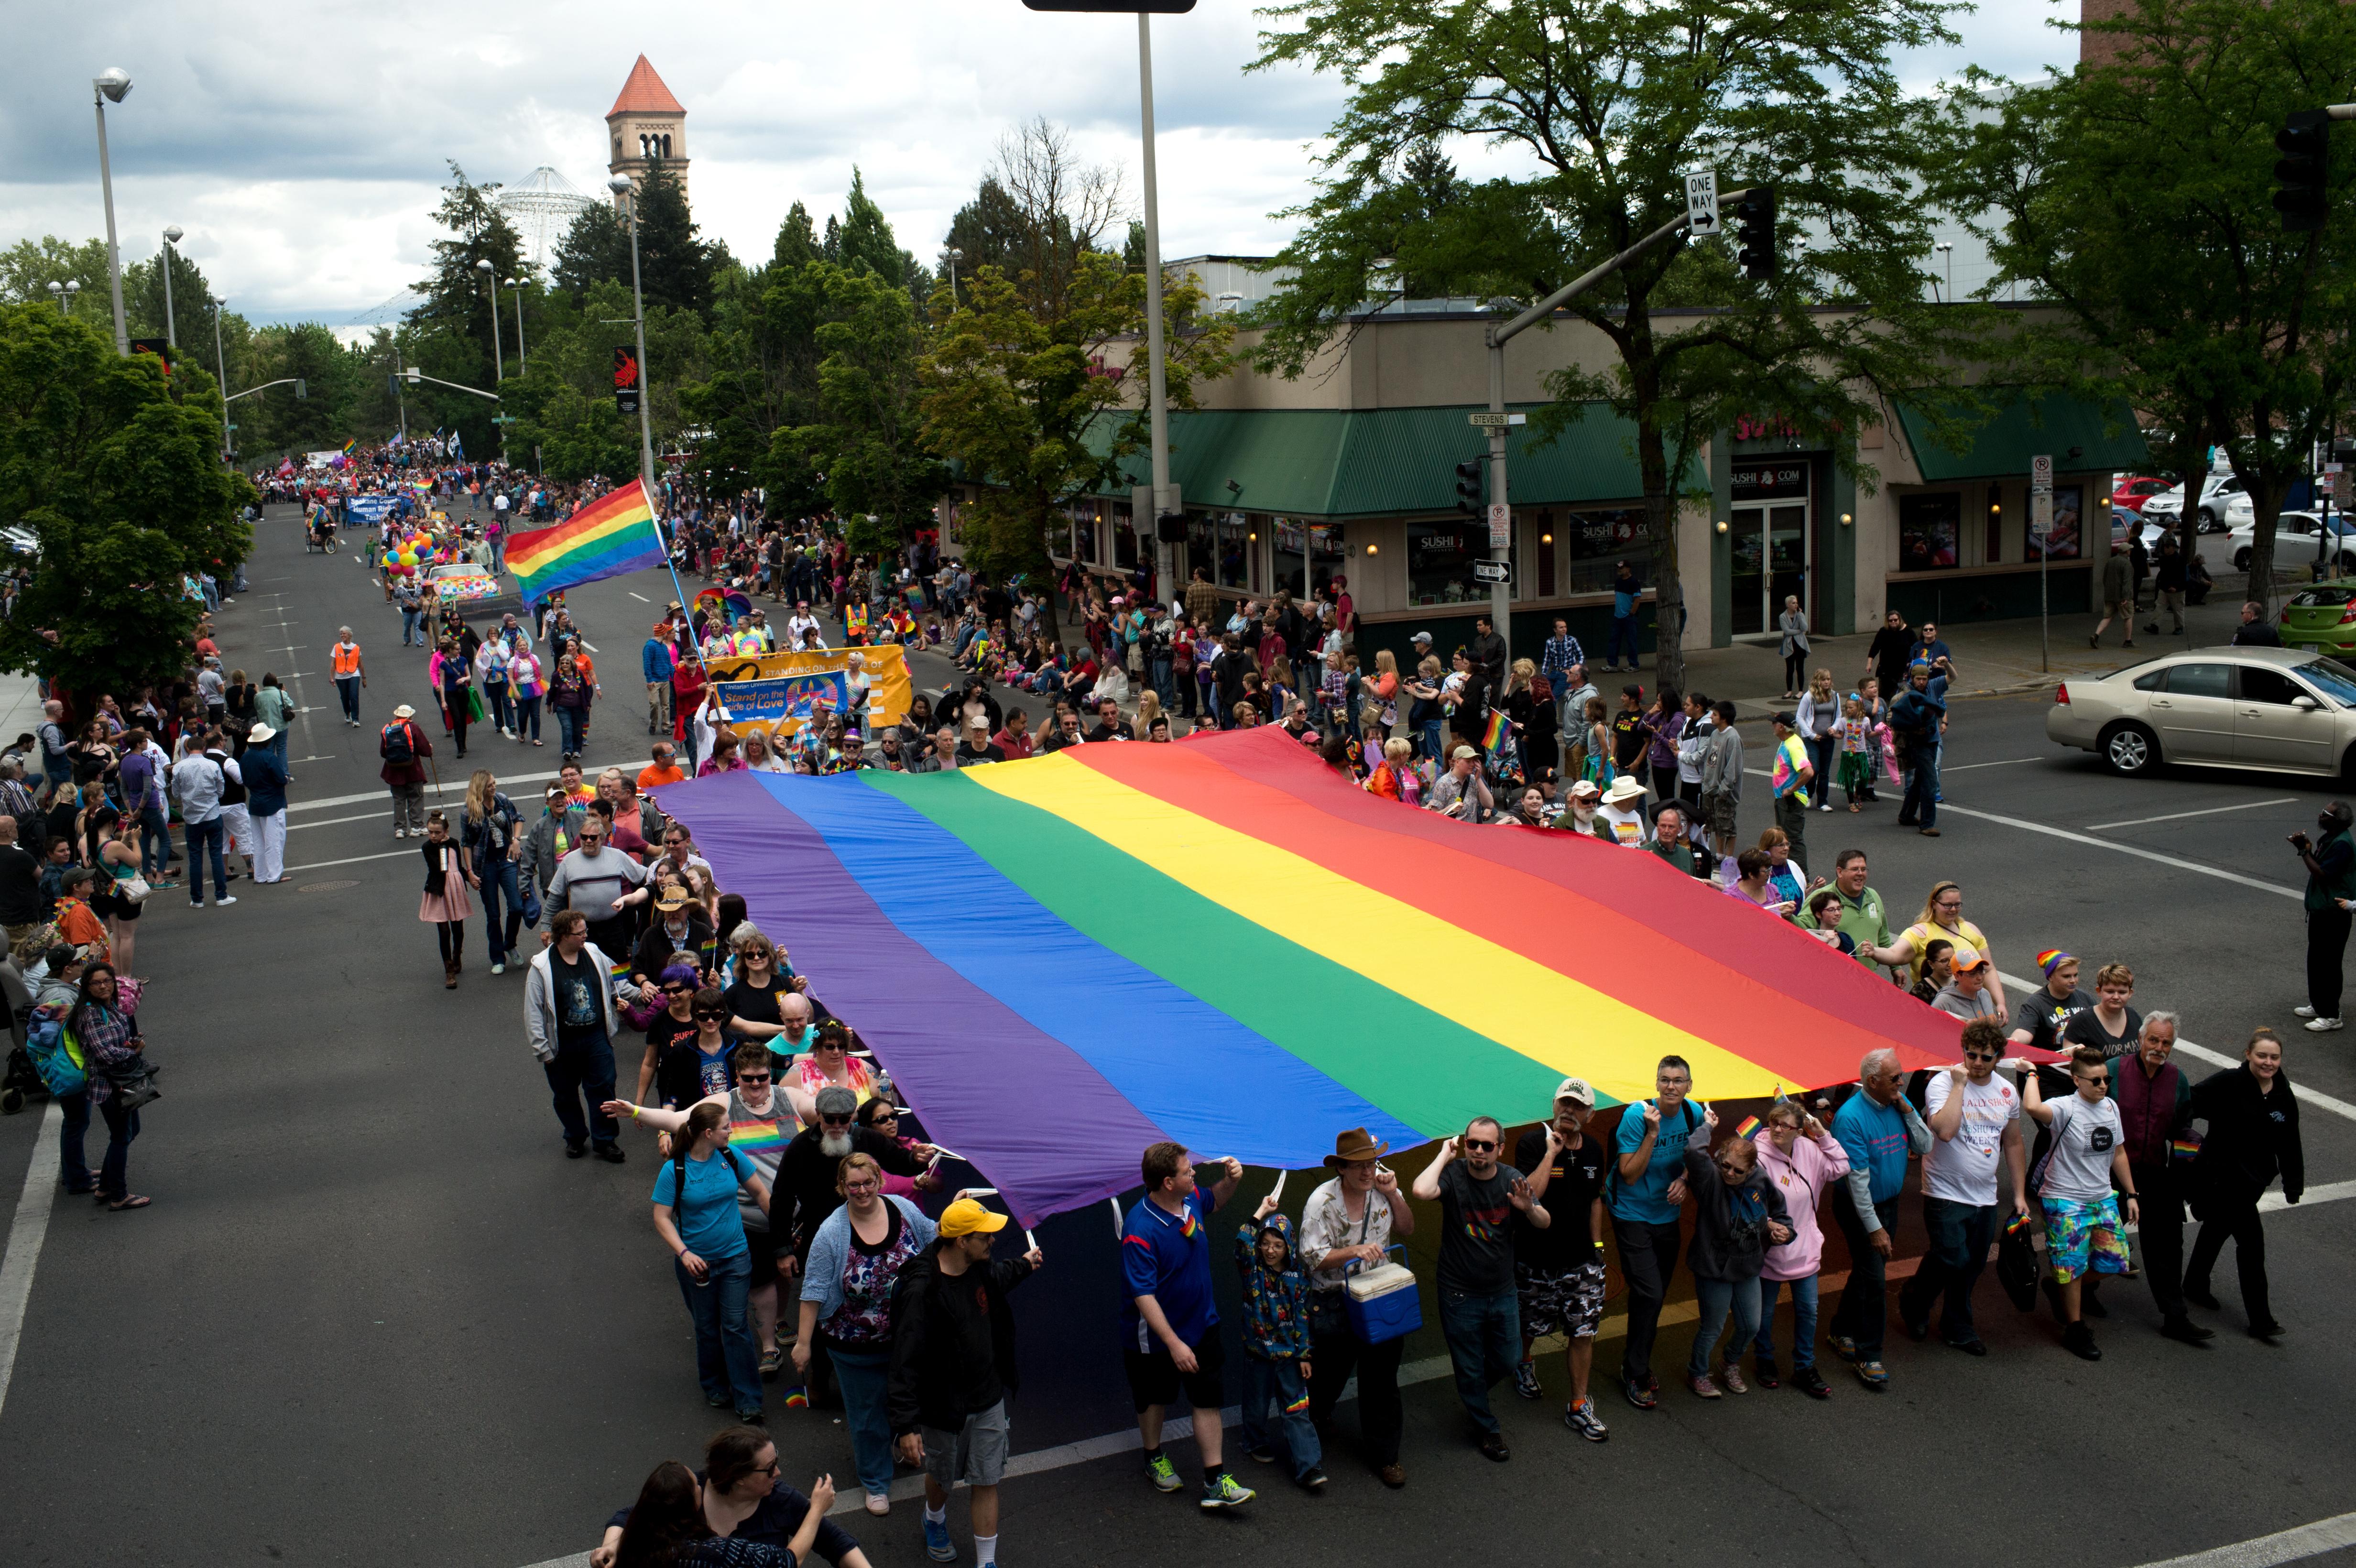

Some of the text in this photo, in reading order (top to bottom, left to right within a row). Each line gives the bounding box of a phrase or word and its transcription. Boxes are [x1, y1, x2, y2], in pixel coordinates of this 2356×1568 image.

[1691, 176, 1711, 193] ONE
[1691, 194, 1712, 210] WAY
[1474, 415, 1504, 424] STEVENS
[1731, 470, 1799, 483] SUSHI COM
[1582, 526, 1613, 537] SUSHI
[1294, 536, 1304, 544] COM
[1310, 538, 1344, 549] SUSHI COM
[1421, 536, 1453, 547] SUSHI
[1477, 566, 1499, 576] ONE WAY
[765, 666, 811, 677] STANDING
[725, 692, 756, 703] Stand
[772, 691, 785, 699] the
[727, 699, 784, 711] side of Love
[1564, 1088, 1585, 1098] Montana
[1967, 1099, 1986, 1107] ALLY
[1965, 1112, 1989, 1121] WHEN
[1973, 1124, 2001, 1134] SHUTS
[1964, 1135, 1989, 1145] WHEN
